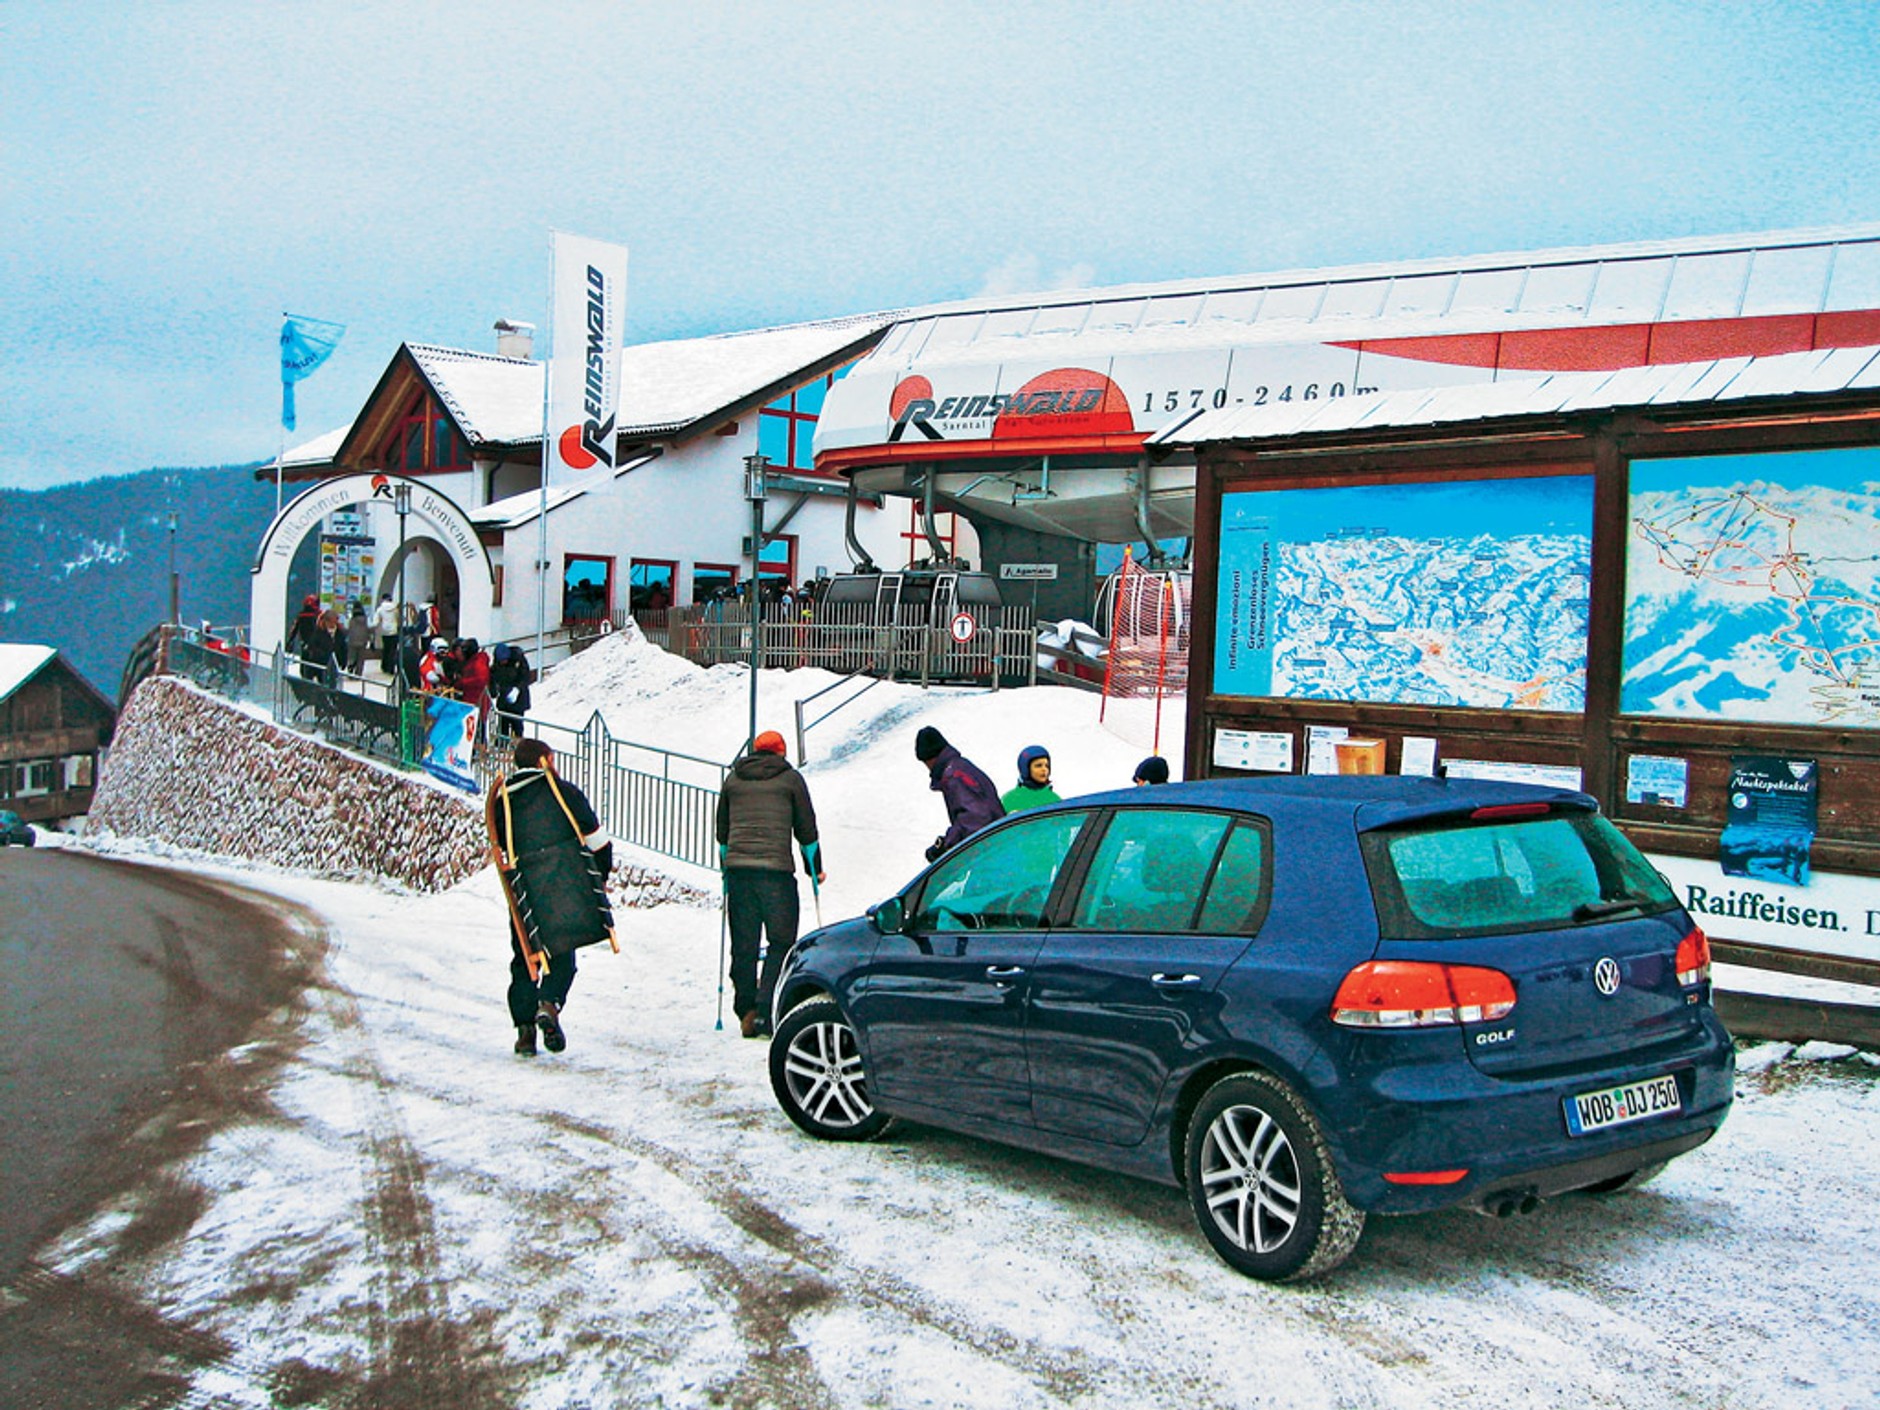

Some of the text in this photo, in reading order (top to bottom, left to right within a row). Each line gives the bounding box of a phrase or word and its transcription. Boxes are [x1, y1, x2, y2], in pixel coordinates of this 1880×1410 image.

[889, 389, 1104, 442] REINSWALD
[272, 489, 352, 558] Willkommen
[421, 494, 478, 561] Benvenuti
[1247, 570, 1259, 650] Grenzenloses
[1229, 624, 1238, 670] Infinite
[1686, 884, 1848, 931] Raiffeisen.
[1476, 1029, 1515, 1045] GOLF
[1577, 1079, 1678, 1128] WOB DJ 250
